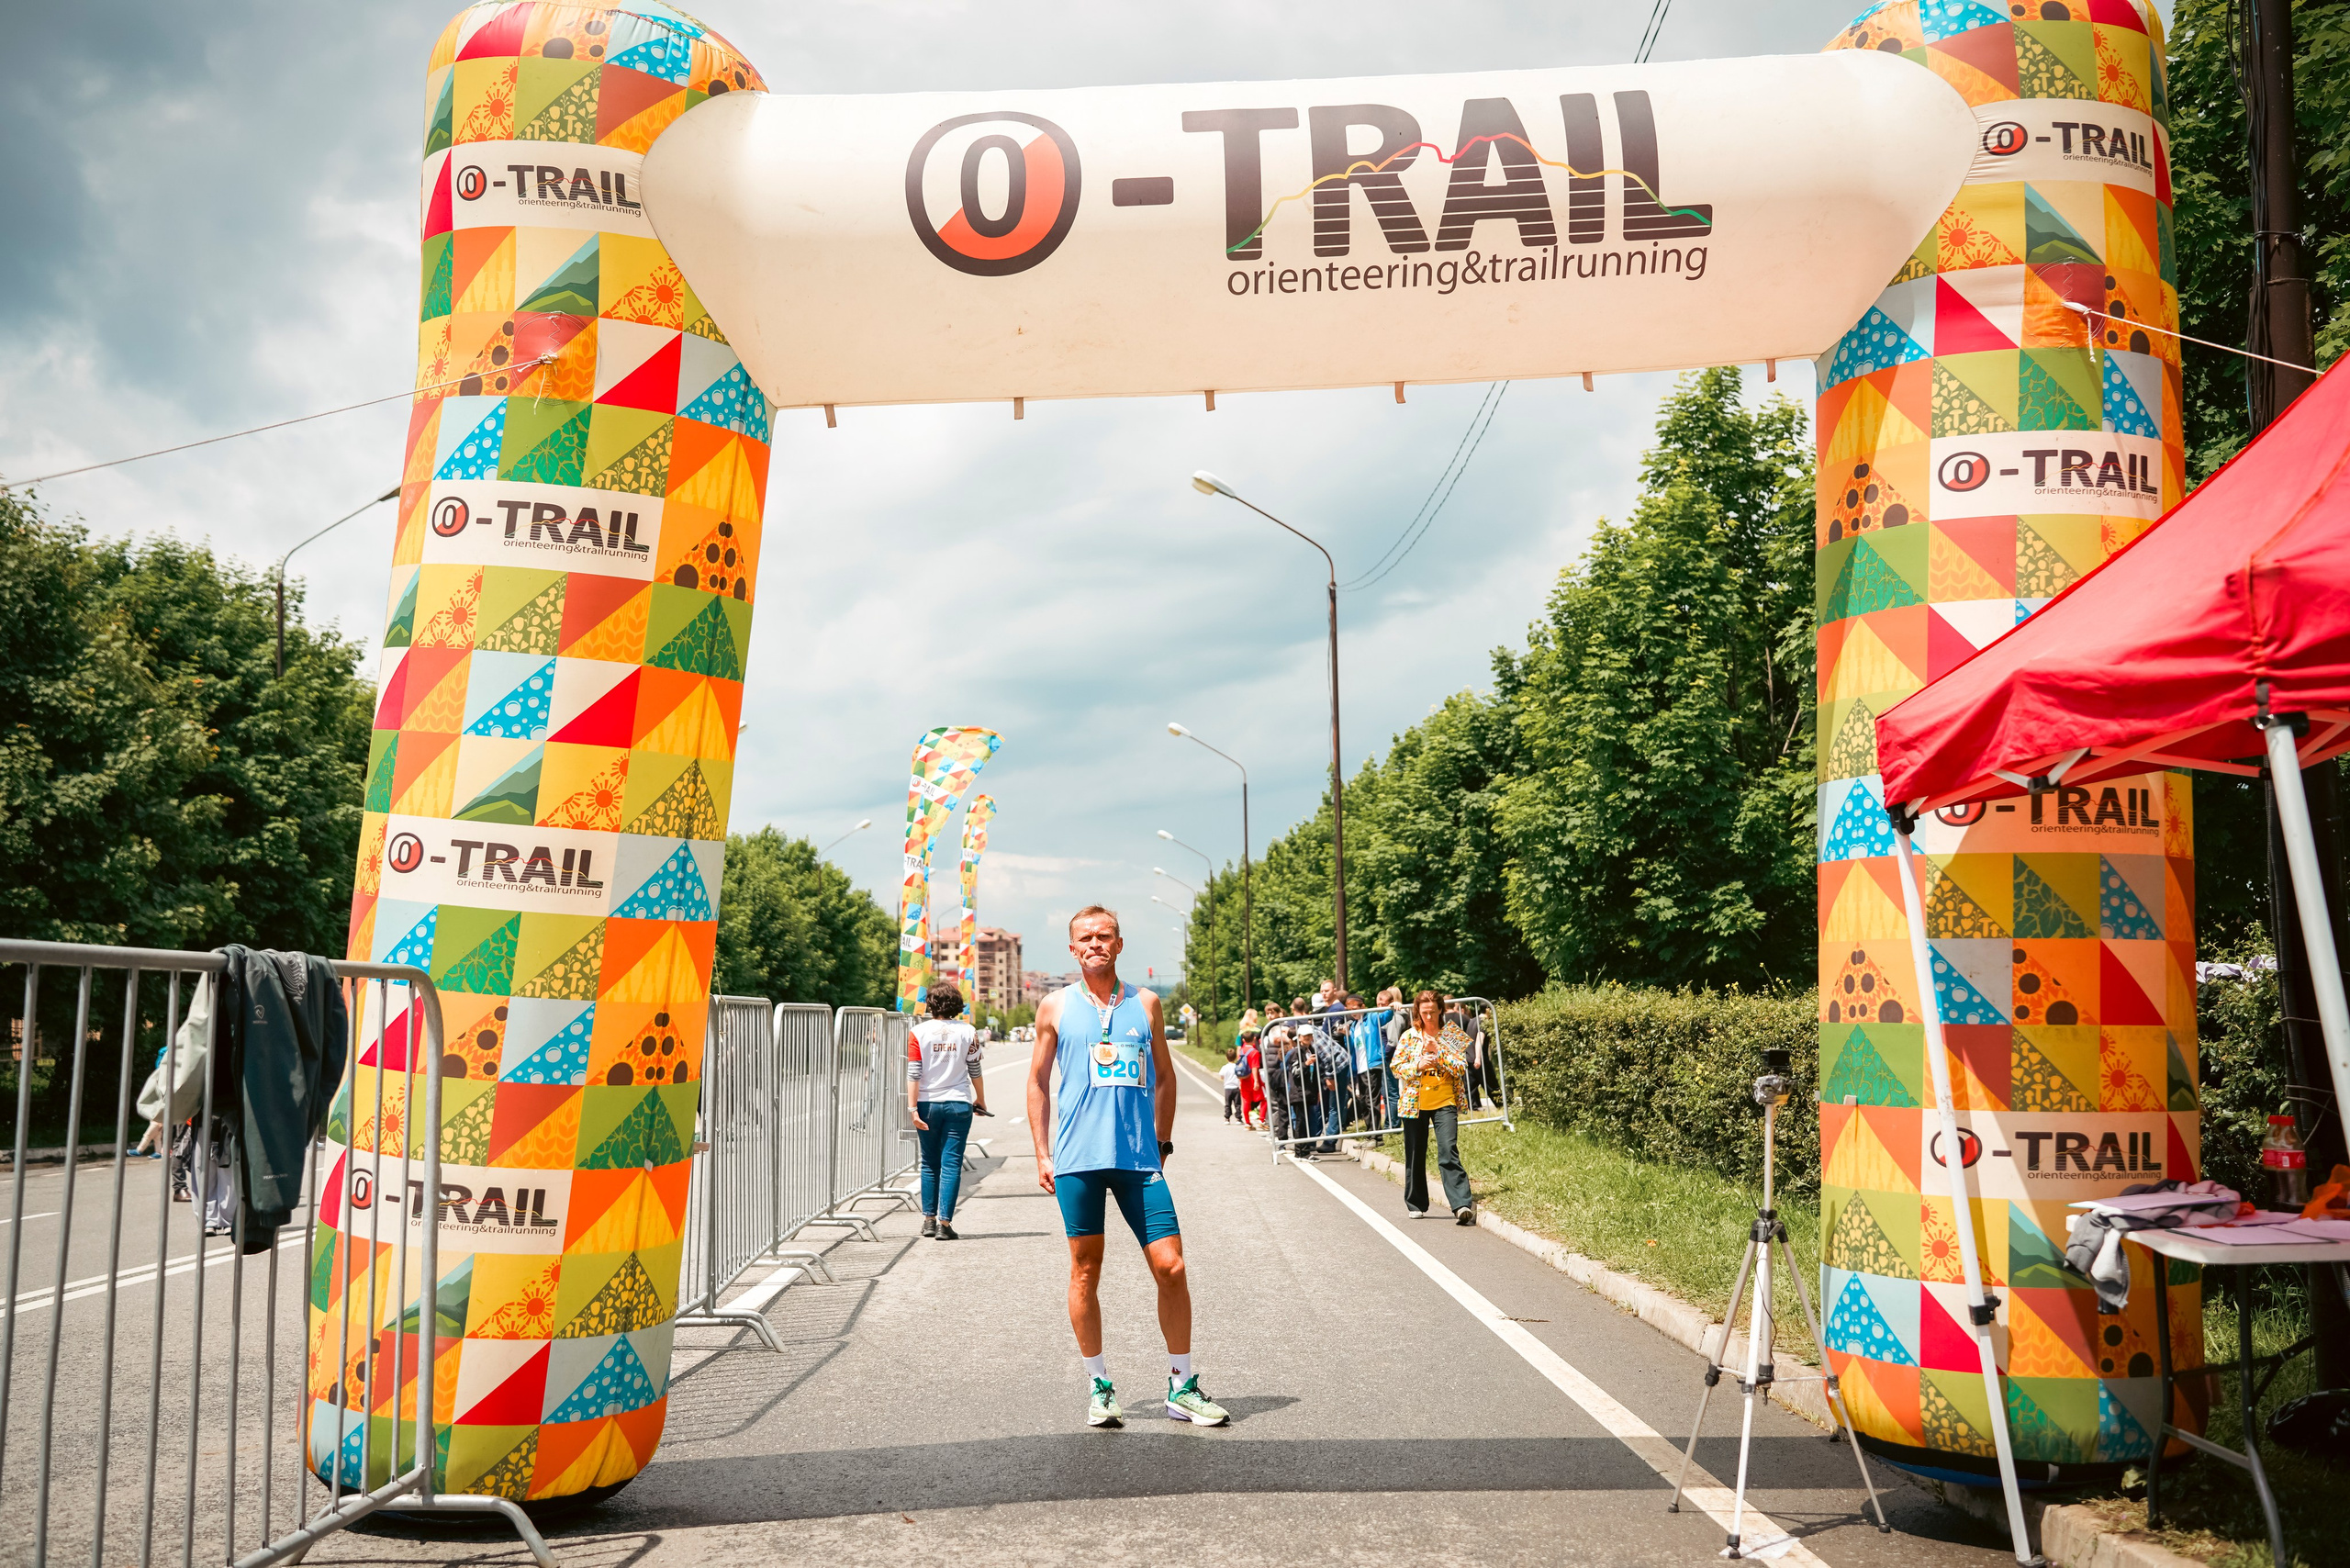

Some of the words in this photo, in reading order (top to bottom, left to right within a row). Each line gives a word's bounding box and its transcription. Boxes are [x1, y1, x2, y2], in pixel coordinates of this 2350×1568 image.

[2063, 153, 2153, 177] orienteering&trailrunning
[518, 197, 641, 218] orienteering&trailrunning
[1227, 242, 1709, 297] orienteering&trailrunning
[2034, 487, 2158, 504] orienteering&trailrunning
[503, 539, 648, 563] orienteering&trailrunning
[2031, 824, 2160, 837] orienteering&trailrunning
[456, 879, 602, 899] orienteering&trailrunning
[933, 1043, 957, 1052] ЕЛЕНА
[1097, 1060, 1140, 1079] 620
[2027, 1170, 2162, 1182] orienteering&trailrunning
[410, 1218, 557, 1238] orteering&trailrunning
